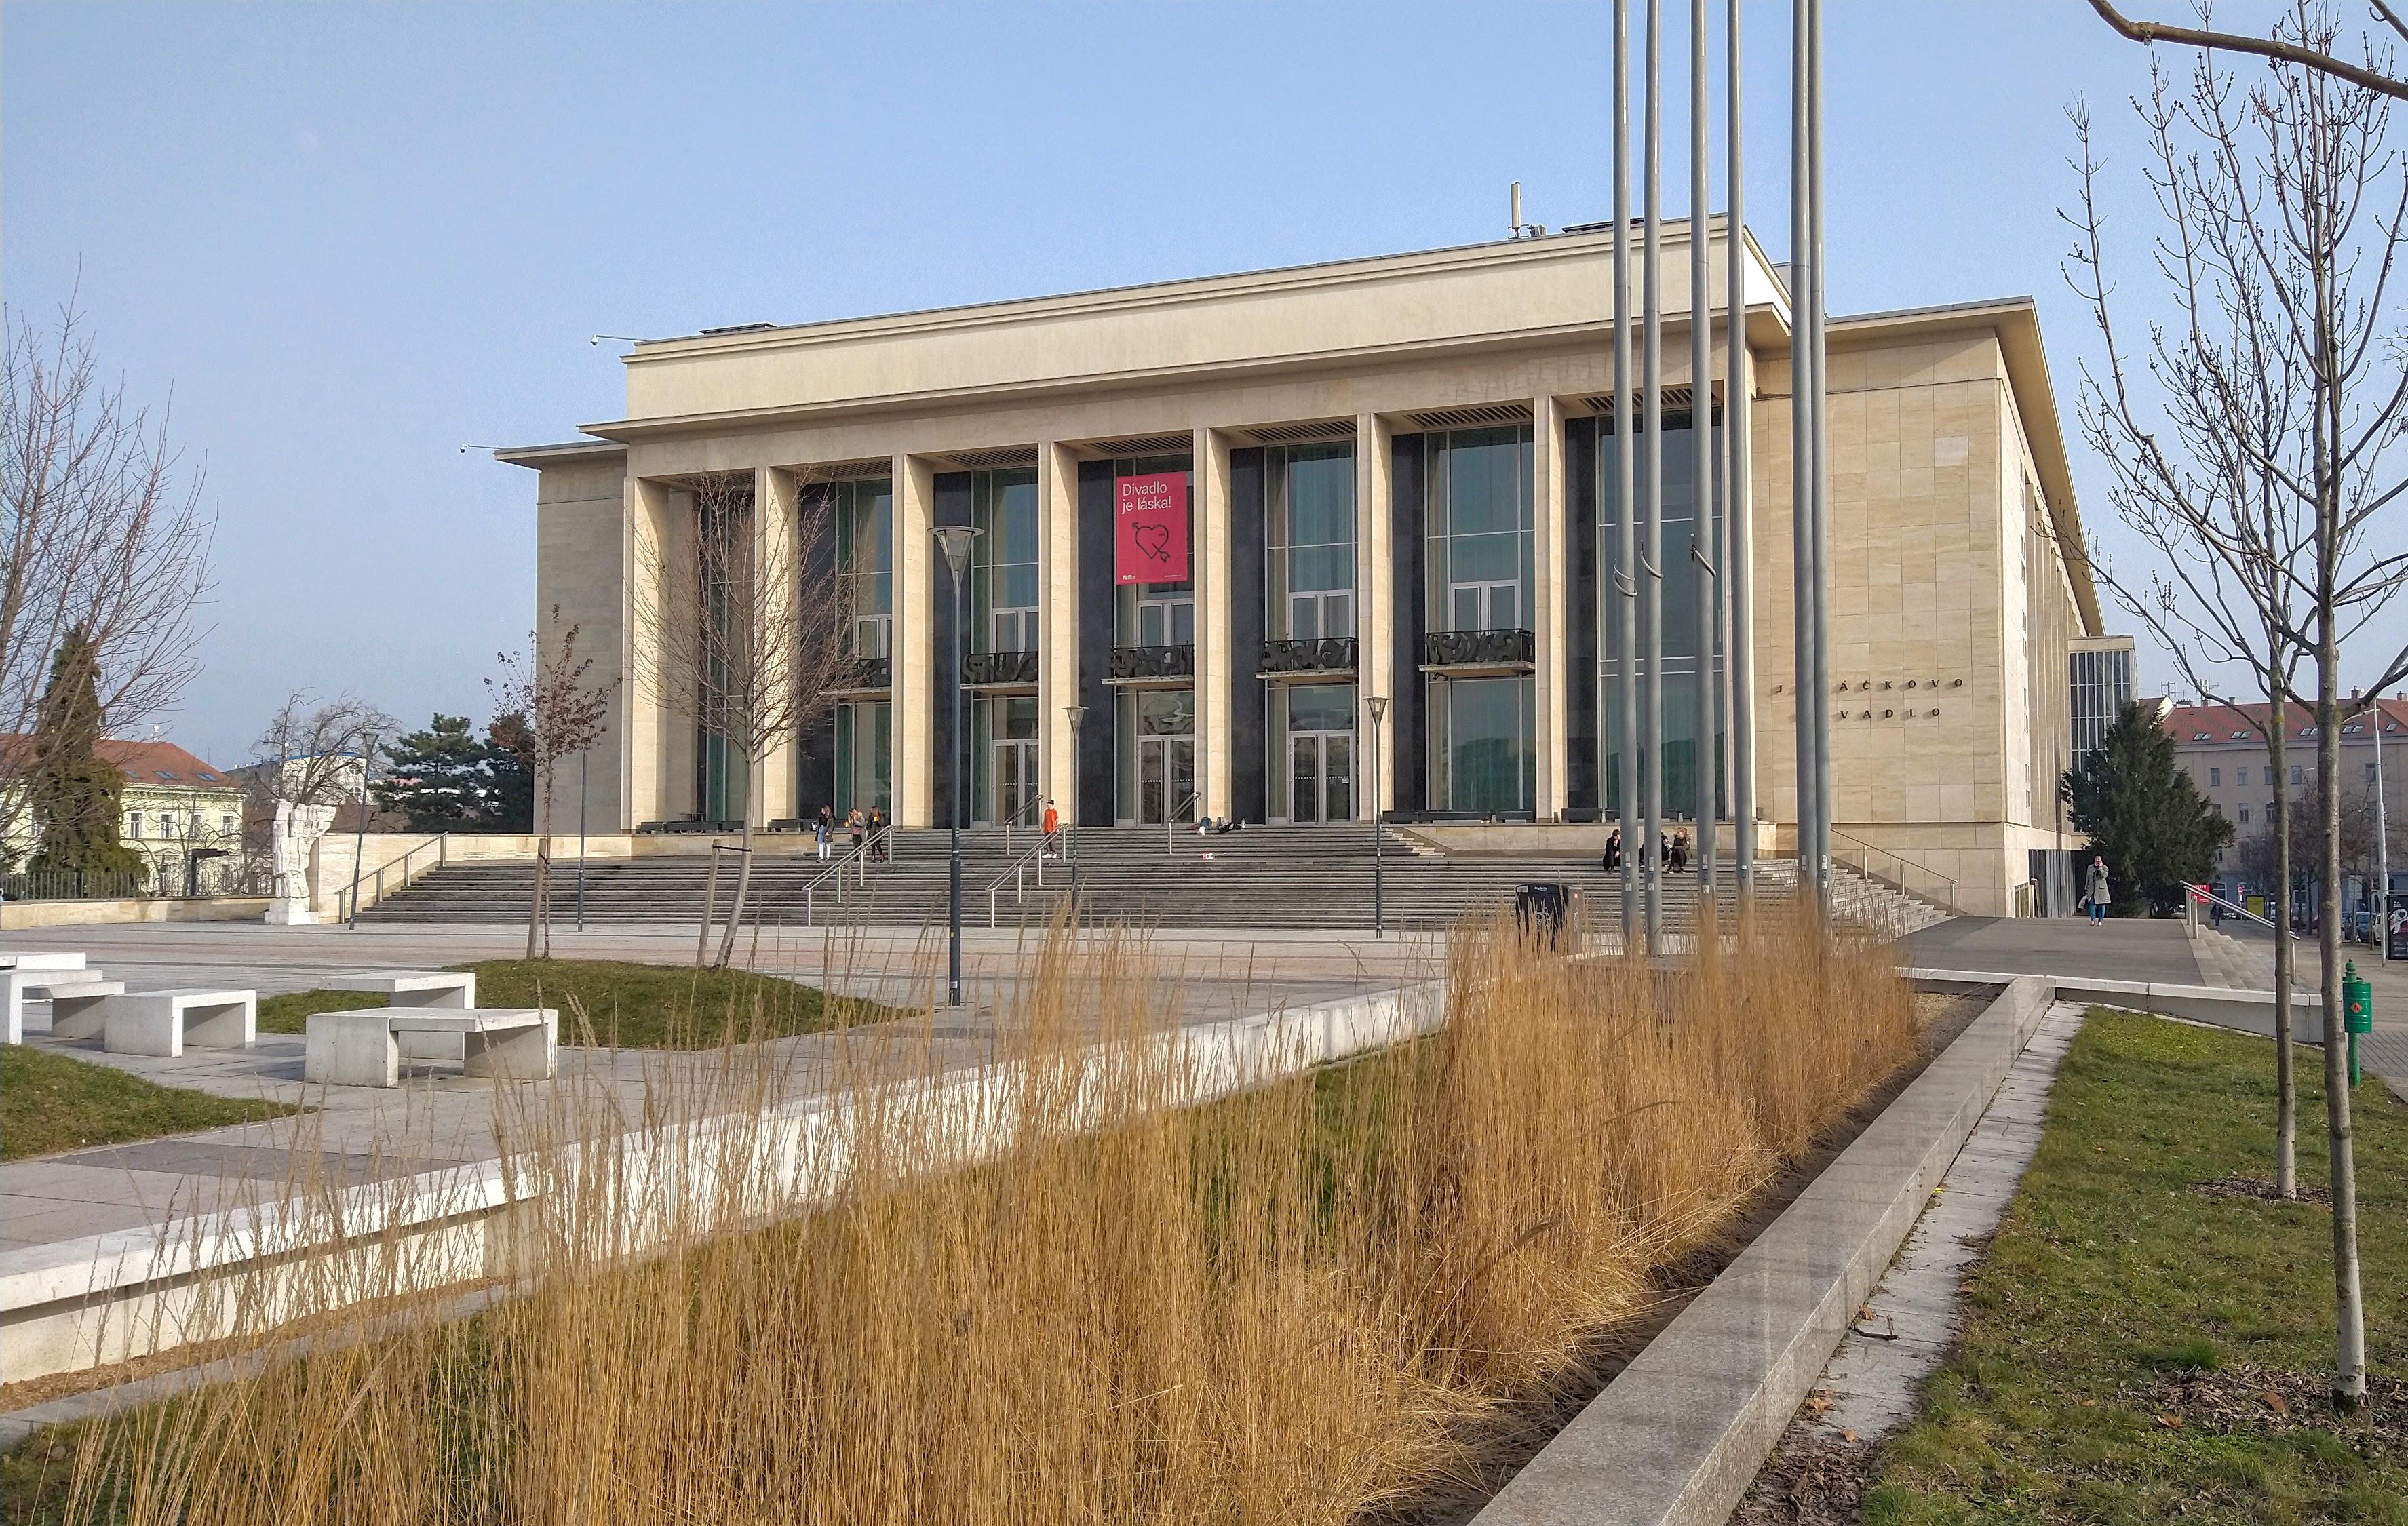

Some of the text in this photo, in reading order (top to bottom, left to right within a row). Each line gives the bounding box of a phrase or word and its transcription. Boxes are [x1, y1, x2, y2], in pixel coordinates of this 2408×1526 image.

[1123, 481, 1167, 496] Divadlo
[1122, 496, 1171, 515] je láska!
[1776, 678, 1962, 693] JÁČKOVO
[1840, 708, 1940, 719] VADLO
